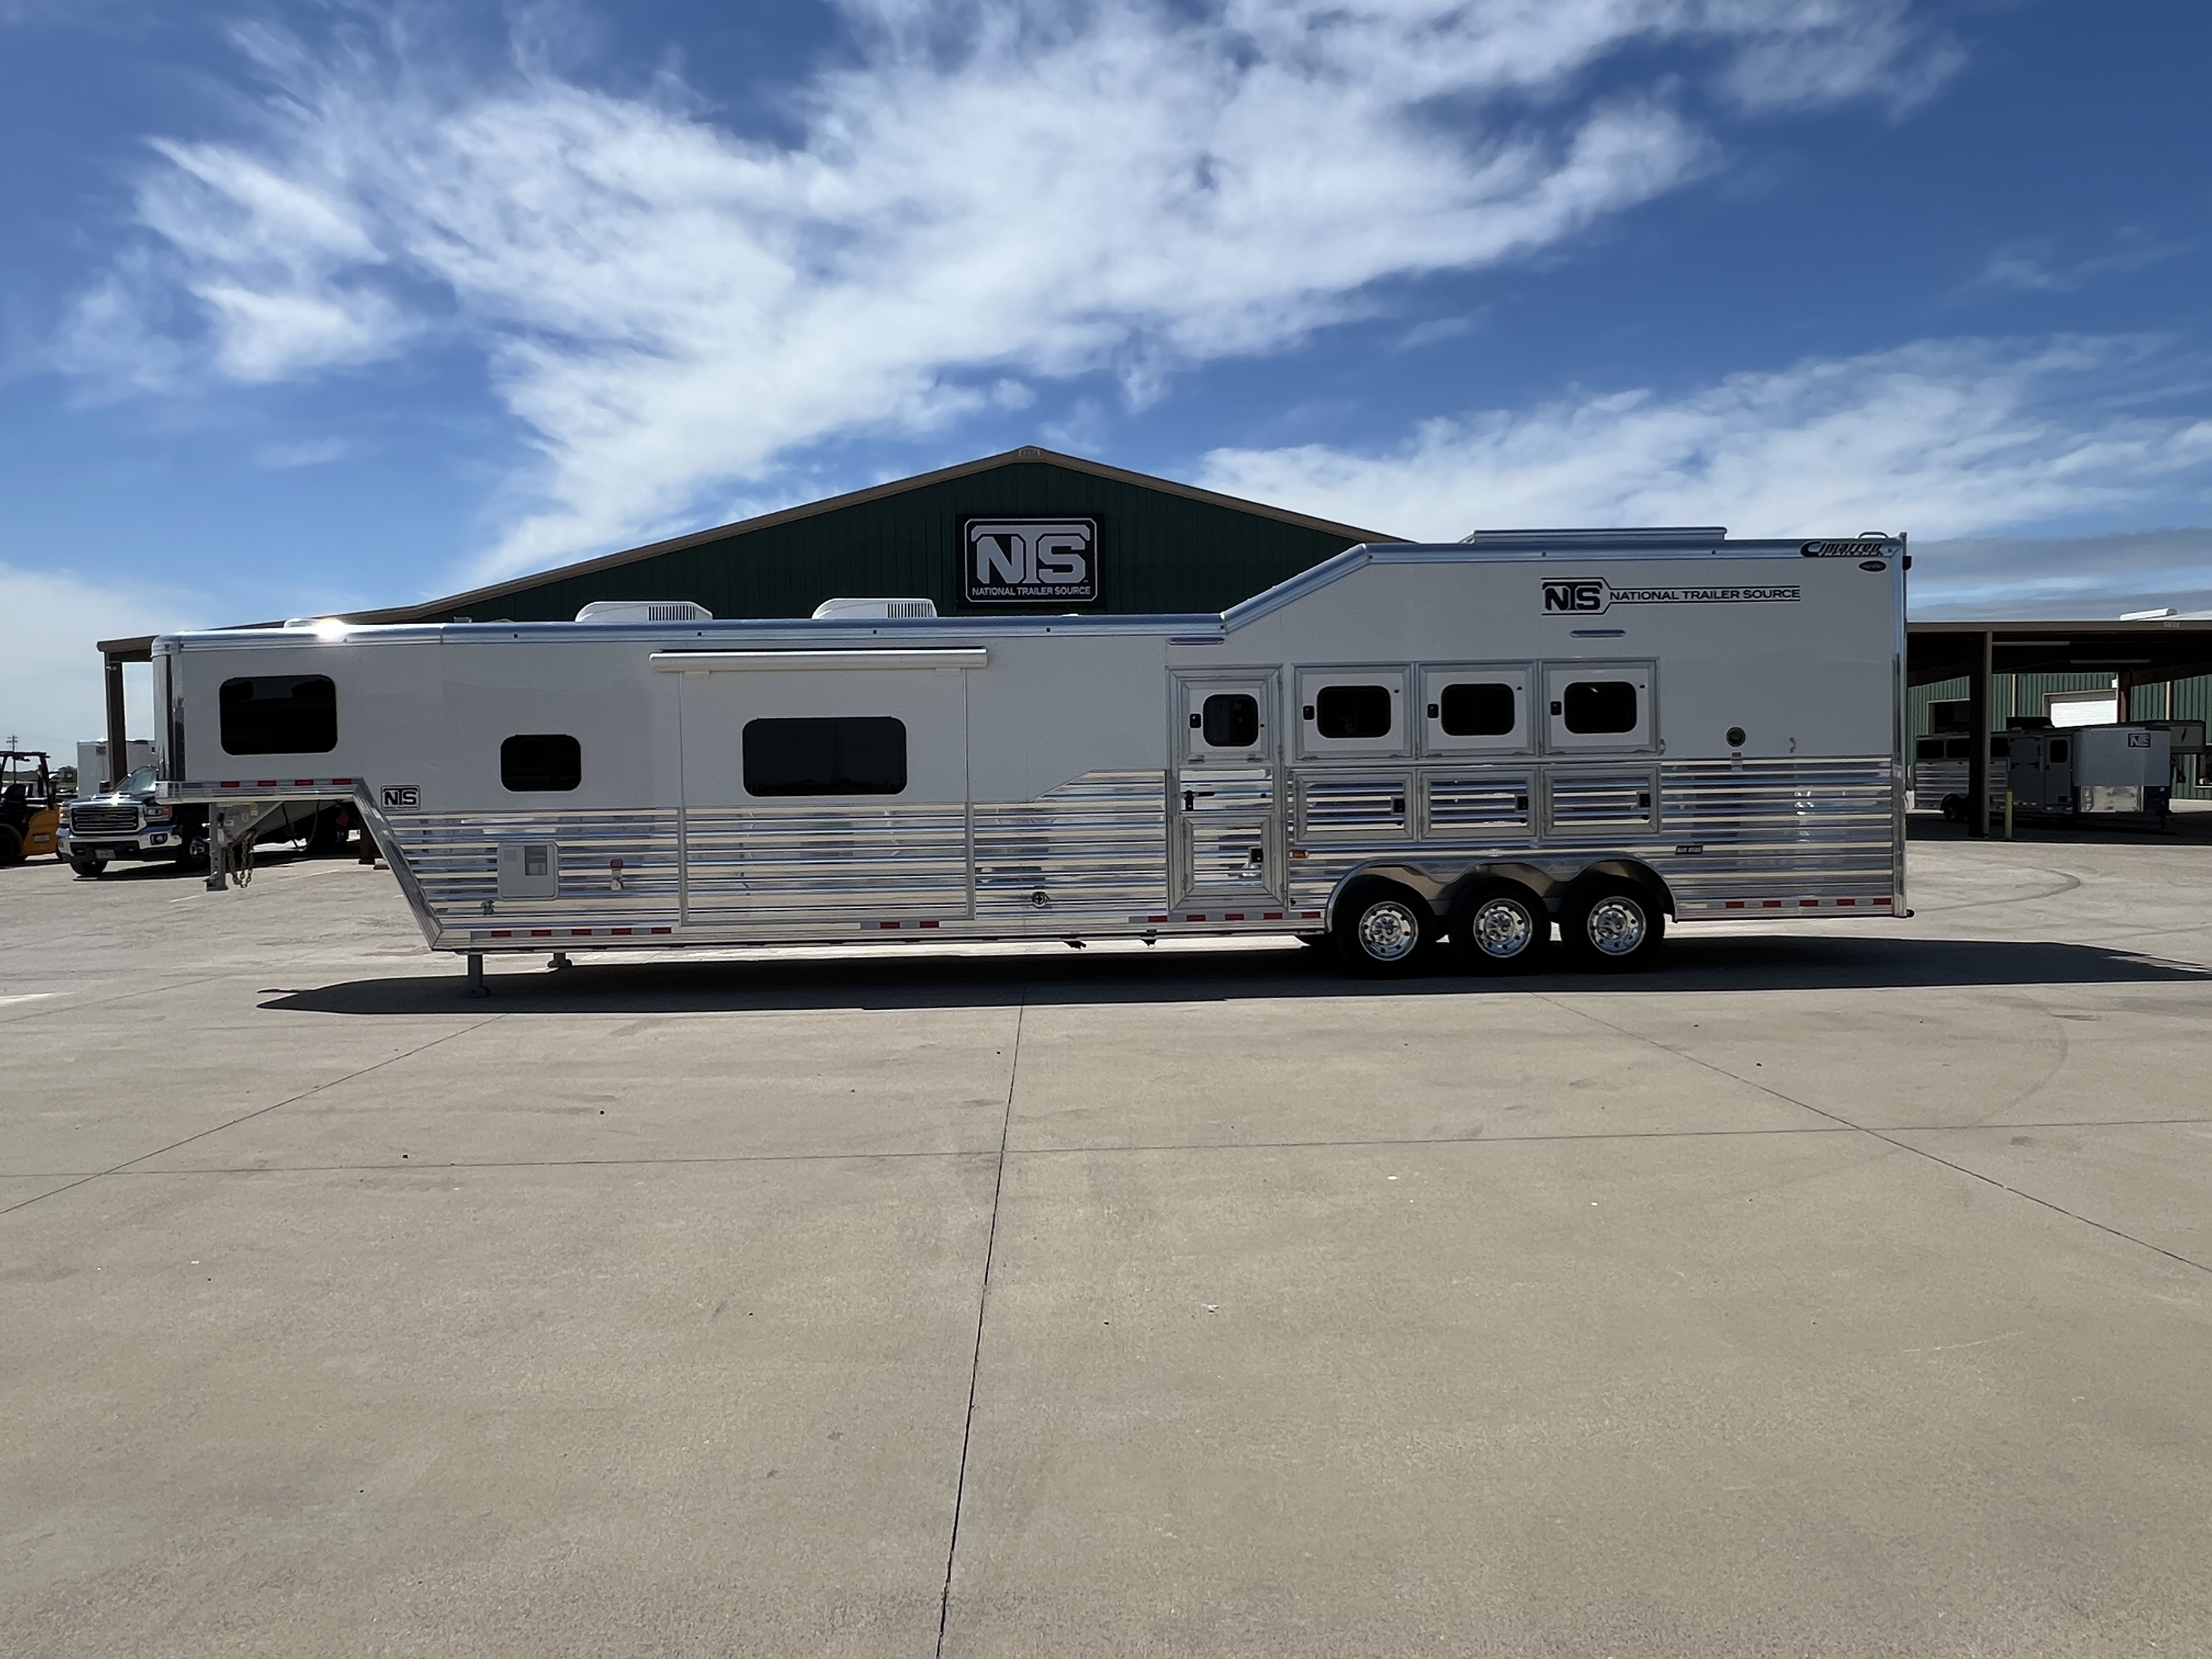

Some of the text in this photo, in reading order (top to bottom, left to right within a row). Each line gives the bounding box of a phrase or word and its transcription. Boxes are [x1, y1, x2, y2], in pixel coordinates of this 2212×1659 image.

[971, 524, 1091, 584] NTS
[972, 586, 1091, 596] NATIONAL TRAILER SOURCE
[1542, 582, 1801, 611] NTS NATIONAL TRAILER SOURCE
[383, 788, 418, 805] NTS
